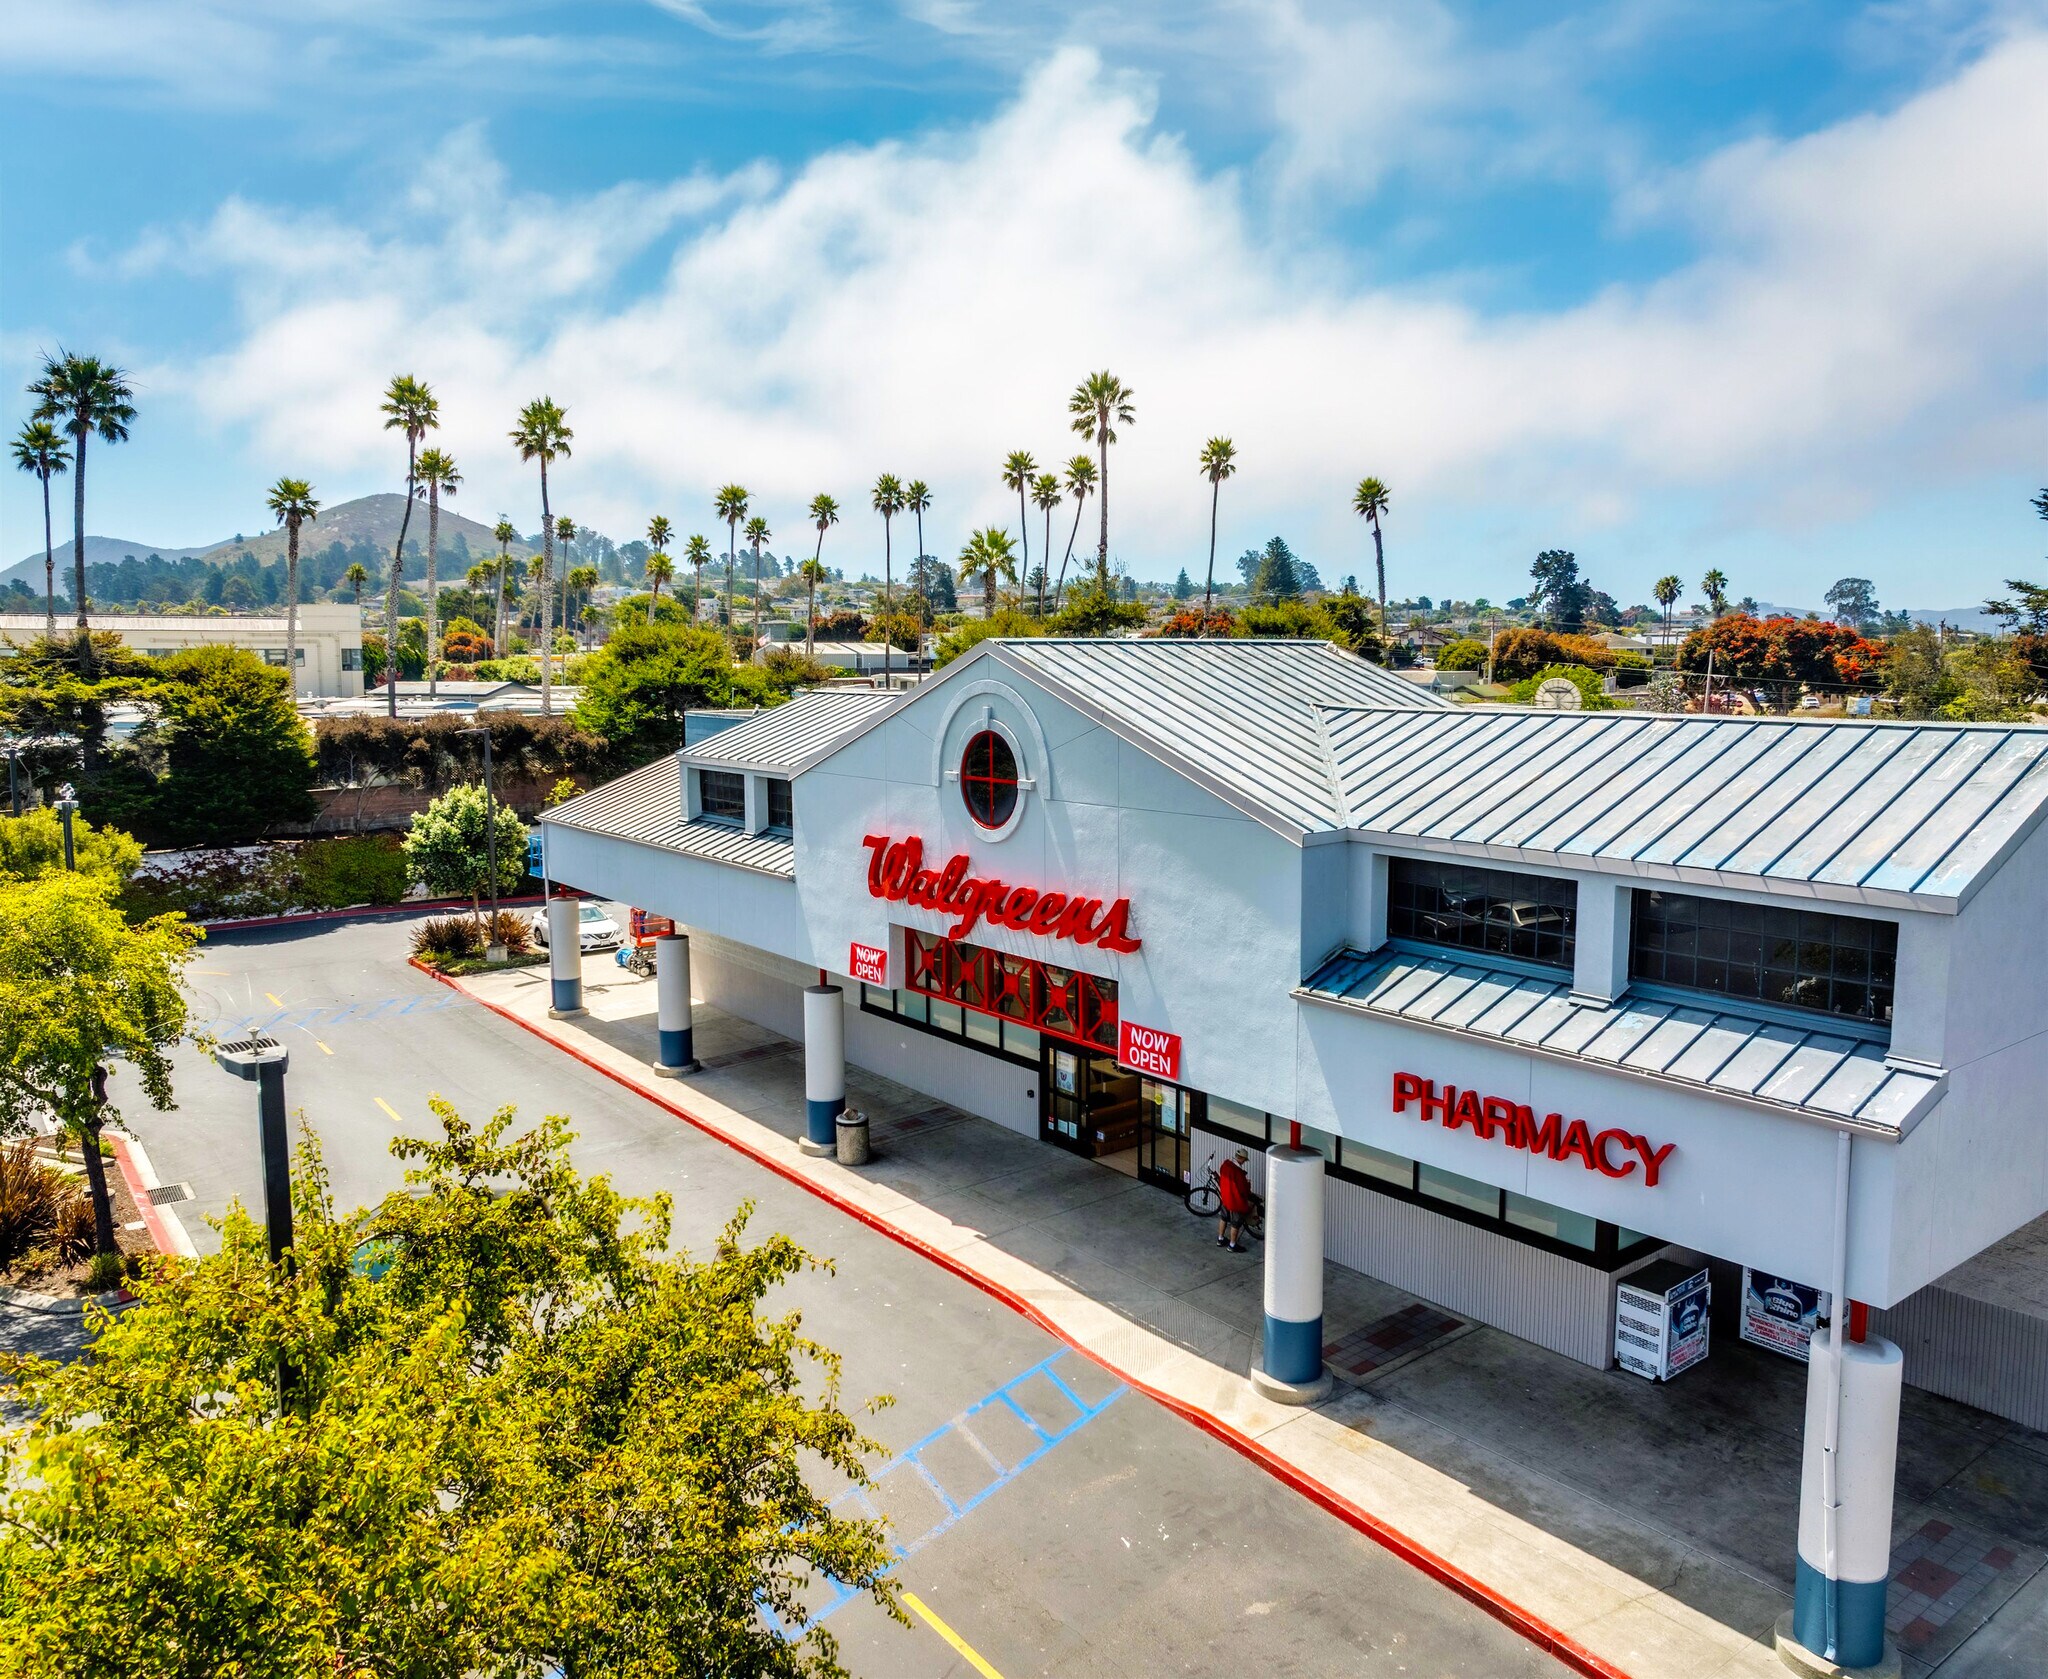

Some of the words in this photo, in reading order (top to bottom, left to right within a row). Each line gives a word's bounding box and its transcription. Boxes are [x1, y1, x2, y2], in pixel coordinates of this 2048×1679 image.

[862, 834, 1142, 954] Walgreens
[856, 946, 880, 966] NOW
[855, 961, 881, 982] OPEN
[1131, 1026, 1170, 1054] NOW
[1129, 1046, 1171, 1075] OPEN
[1392, 1071, 1677, 1188] PHARMACY
[1769, 1303, 1799, 1319] Rhino
[1772, 1296, 1796, 1310] Blue
